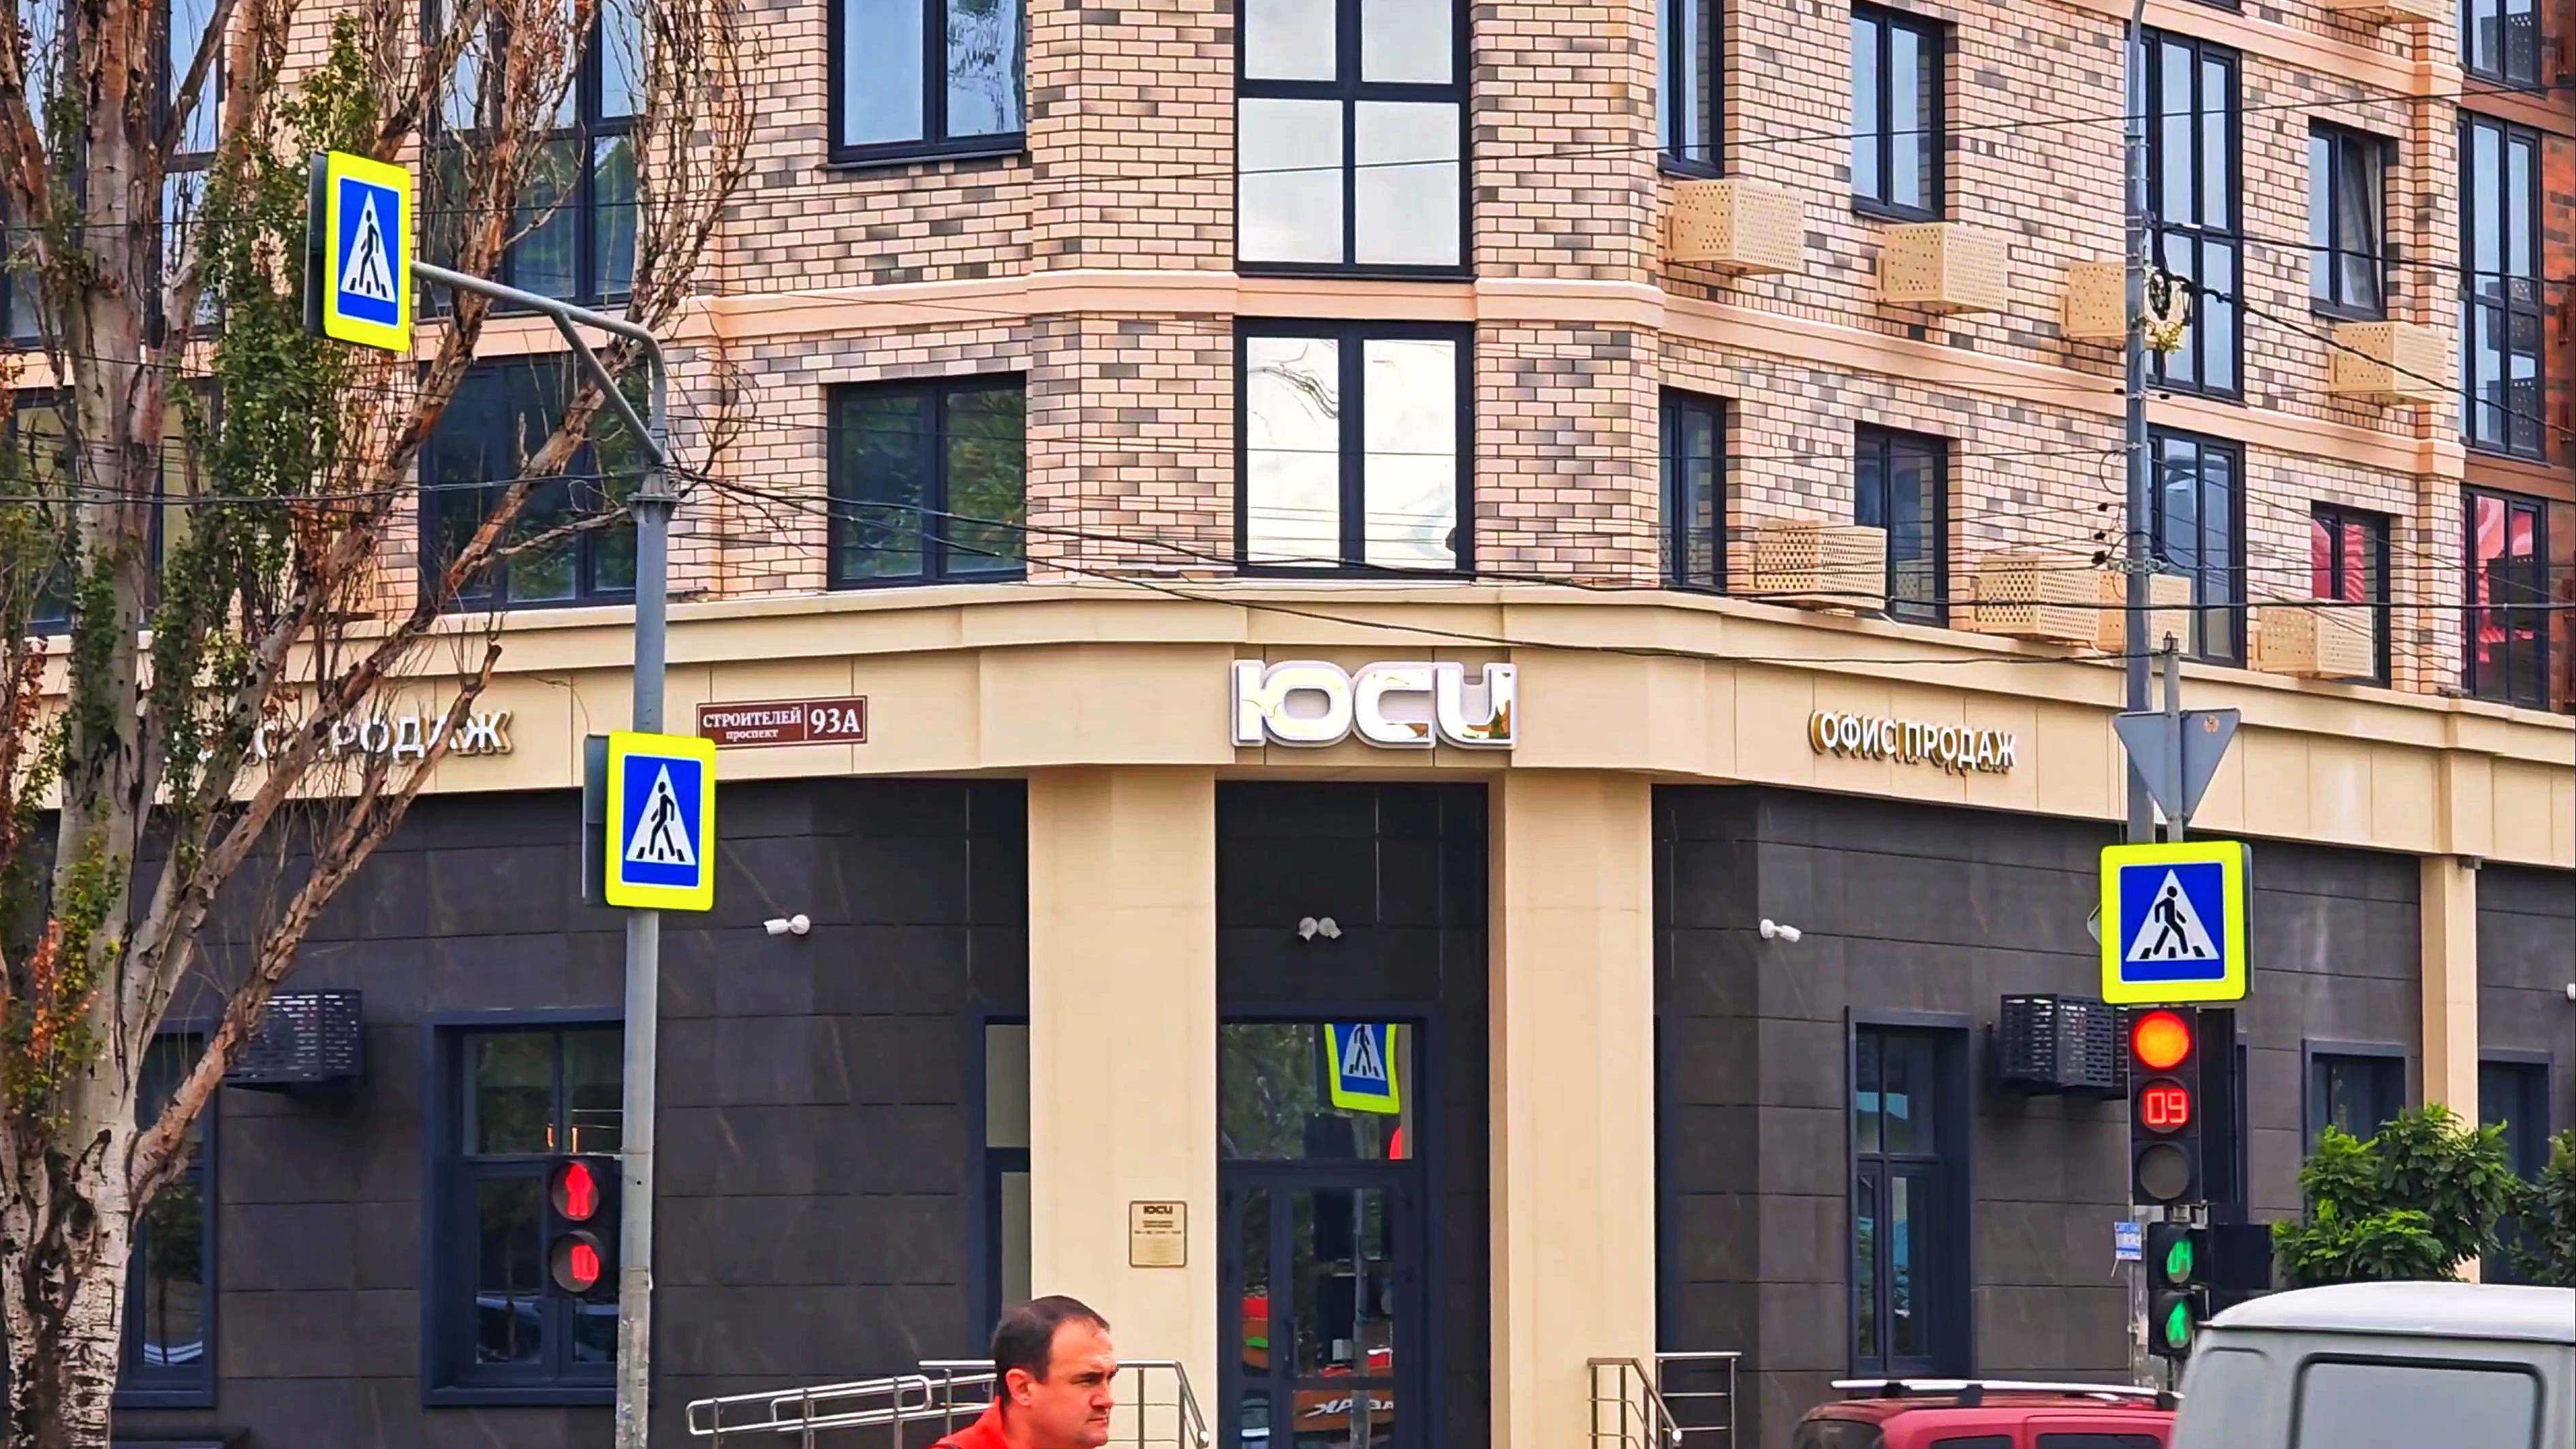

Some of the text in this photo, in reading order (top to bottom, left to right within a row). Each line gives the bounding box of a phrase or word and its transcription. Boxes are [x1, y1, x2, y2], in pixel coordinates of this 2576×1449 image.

[702, 706, 802, 728] СТРОИТЕЛЕЙ
[811, 708, 861, 734] 93А
[725, 729, 779, 742] проспект
[1817, 712, 2016, 769] ОФИС ПРОДАЖ
[2144, 1090, 2188, 1126] 09
